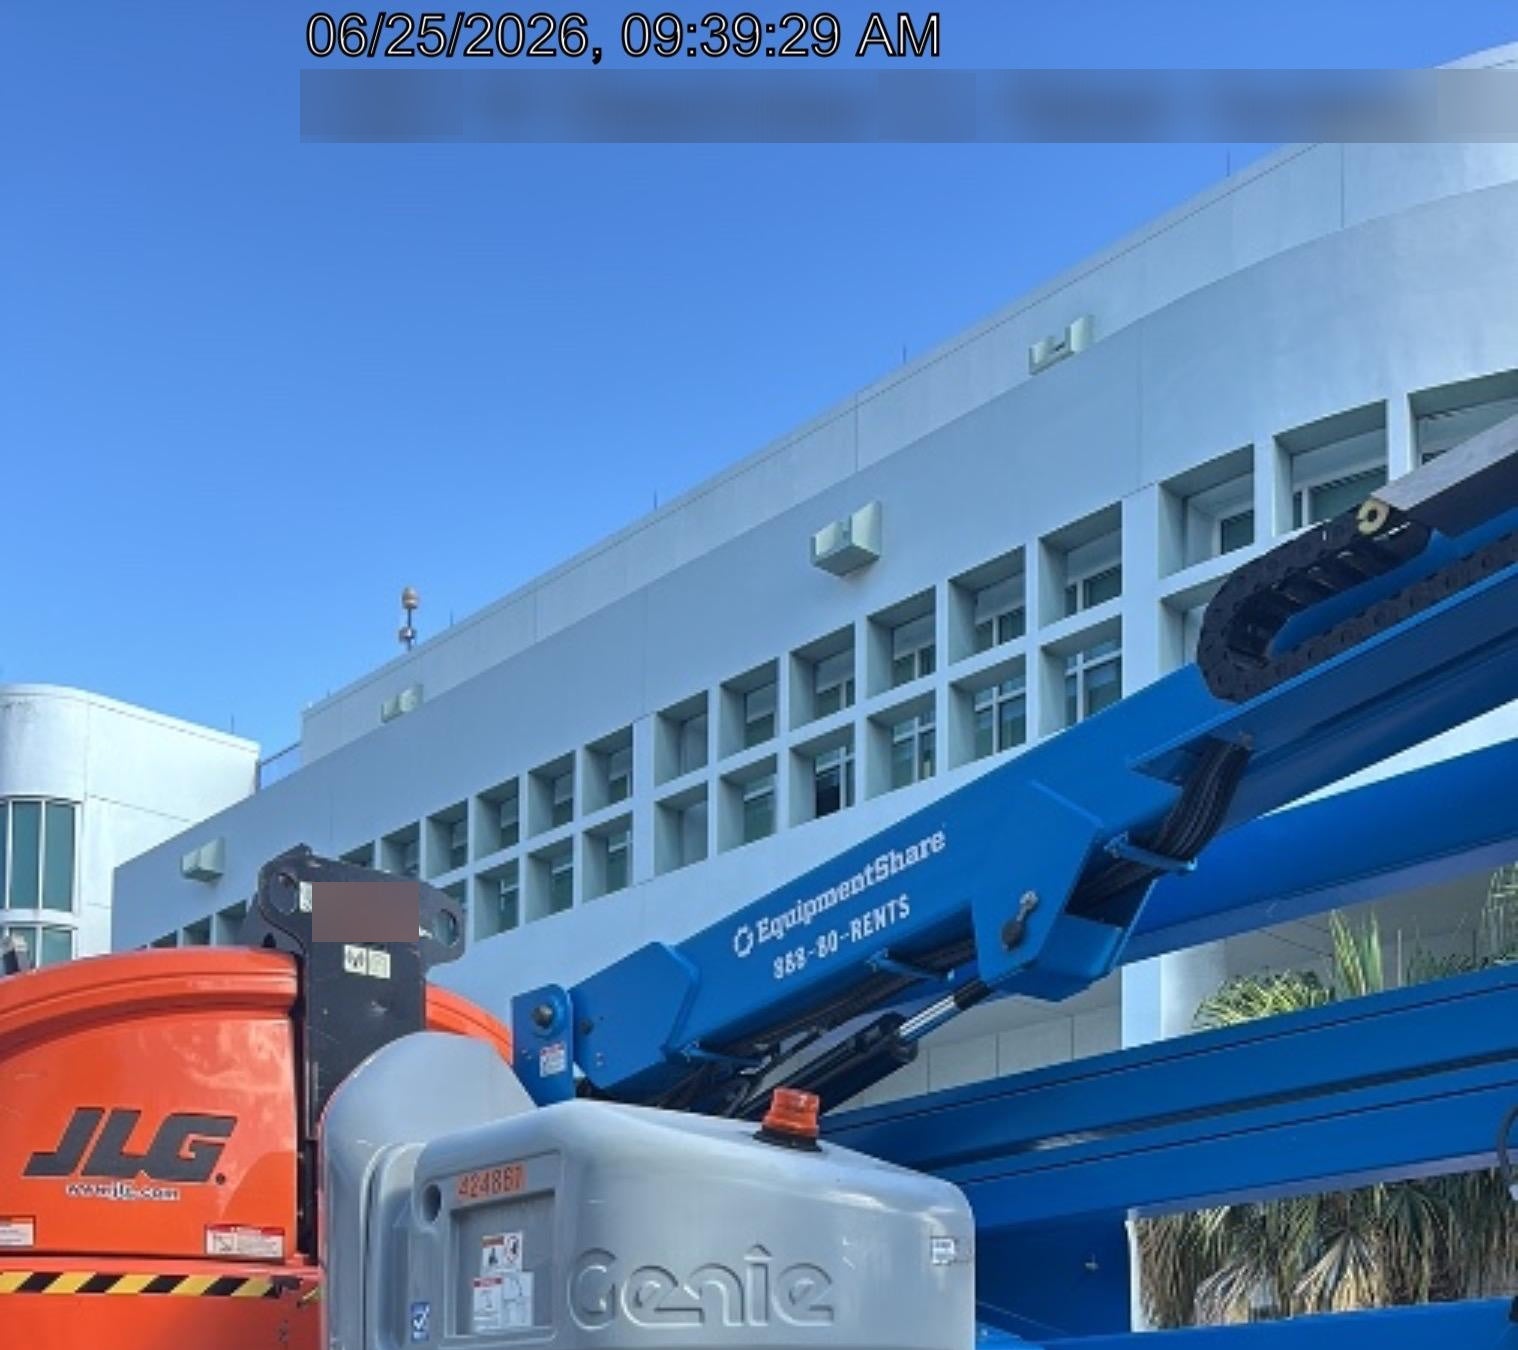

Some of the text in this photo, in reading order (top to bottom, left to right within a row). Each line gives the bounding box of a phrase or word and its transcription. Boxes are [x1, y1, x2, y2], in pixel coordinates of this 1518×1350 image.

[756, 830, 946, 943] EquipmentShare
[22, 1107, 238, 1184] JLG
[567, 1244, 834, 1329] Genie
